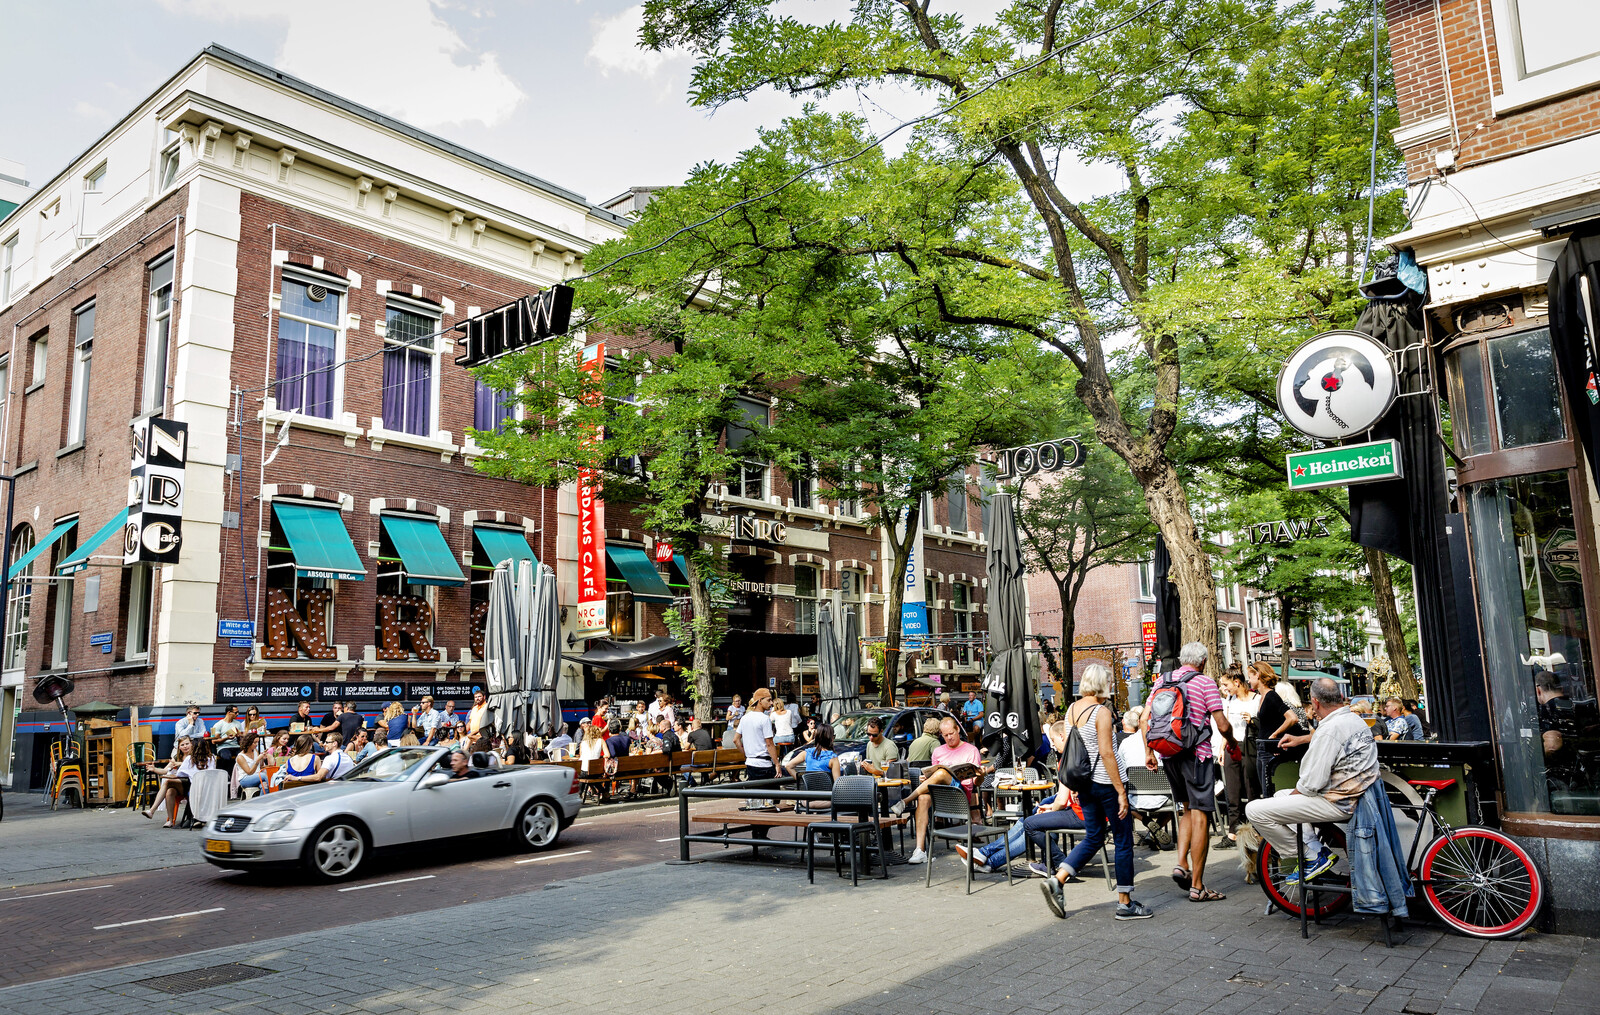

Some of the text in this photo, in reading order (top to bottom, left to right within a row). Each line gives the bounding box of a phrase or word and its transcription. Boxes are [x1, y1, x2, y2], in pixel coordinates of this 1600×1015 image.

[1309, 452, 1391, 476] Heineken
[657, 544, 673, 561] illy
[307, 570, 334, 579] ABSOLUT
[583, 552, 598, 598] CAFÉ
[577, 607, 595, 619] NRC
[903, 611, 918, 619] FOTO
[904, 622, 922, 630] VIDEO
